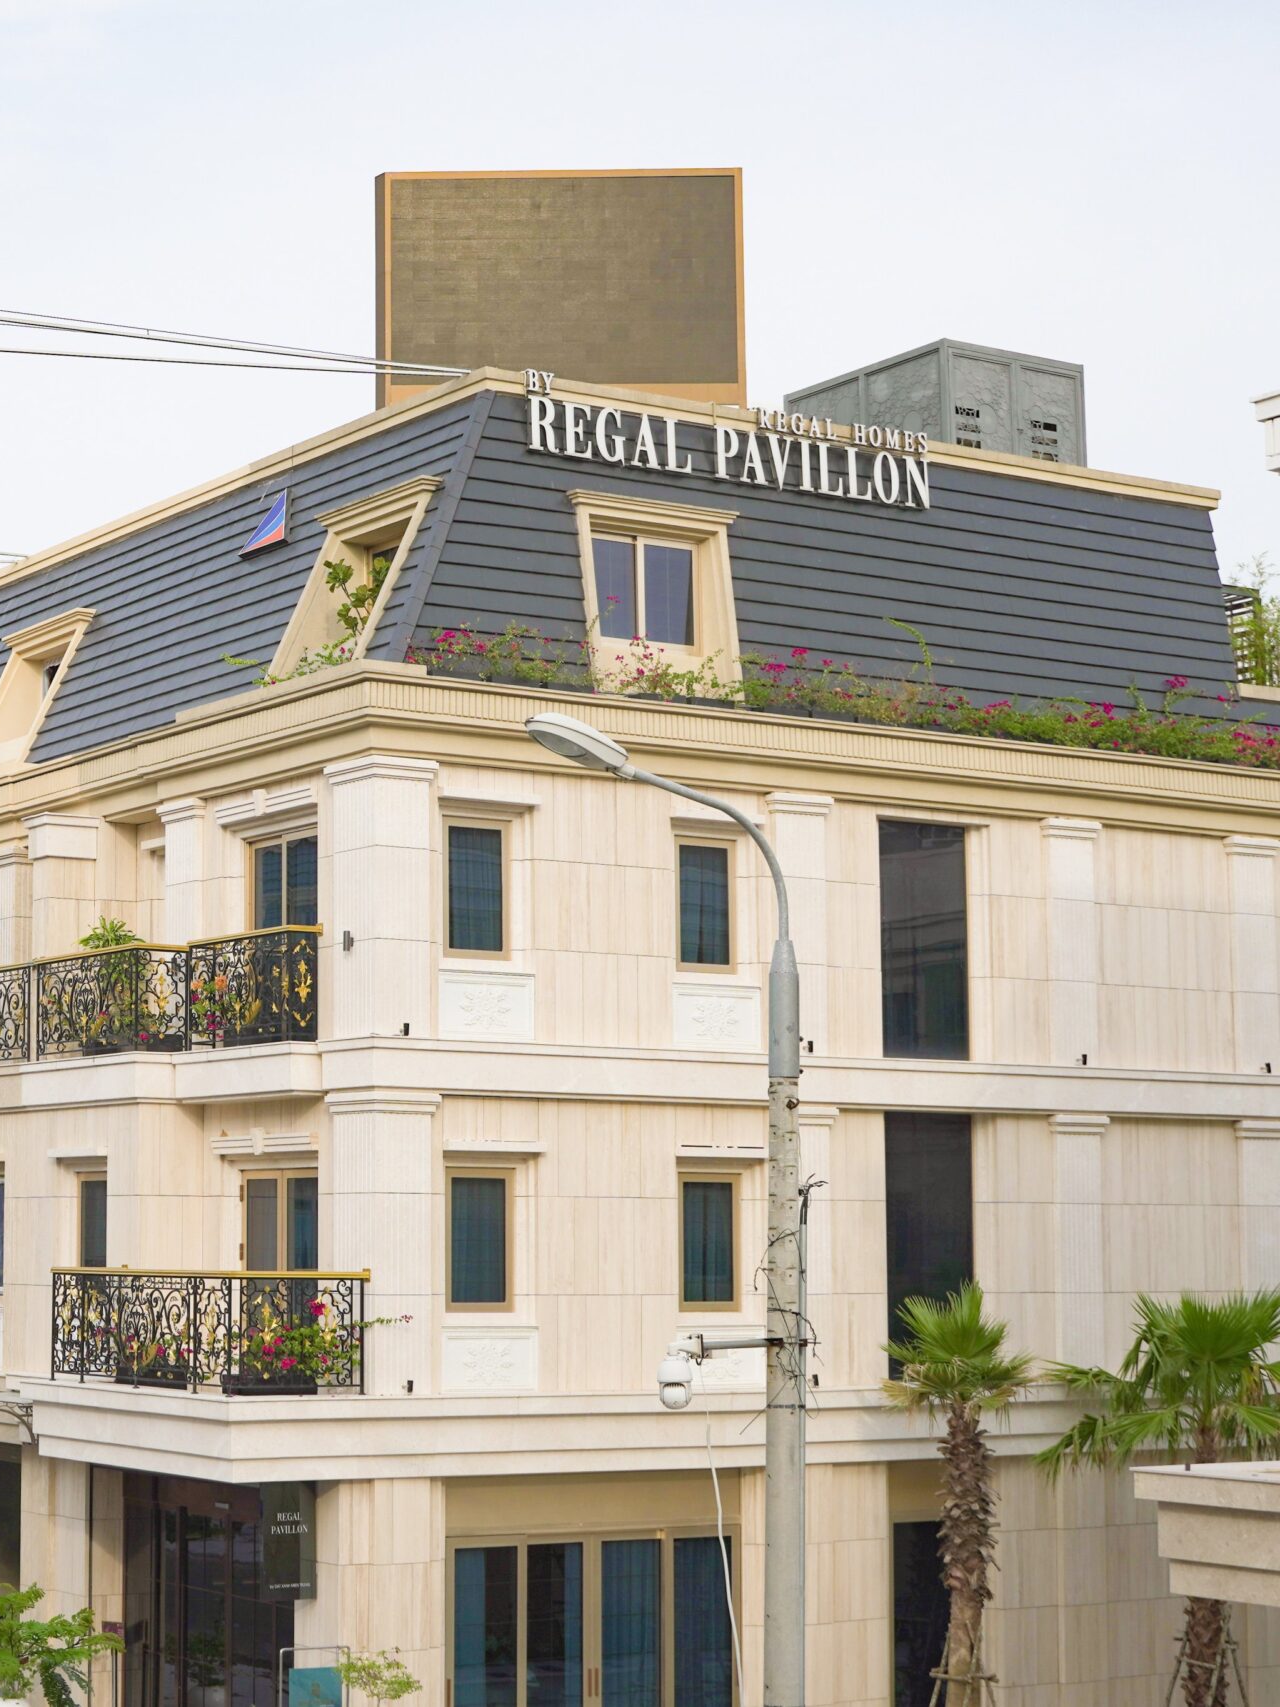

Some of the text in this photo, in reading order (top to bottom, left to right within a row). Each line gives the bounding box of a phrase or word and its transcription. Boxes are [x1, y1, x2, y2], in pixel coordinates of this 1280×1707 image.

[524, 368, 555, 394] BY
[759, 408, 929, 454] REGAL HOMES
[528, 395, 931, 510] REGAL PAVILLON
[271, 1524, 308, 1534] PAVILLON
[277, 1512, 302, 1521] REGAL
